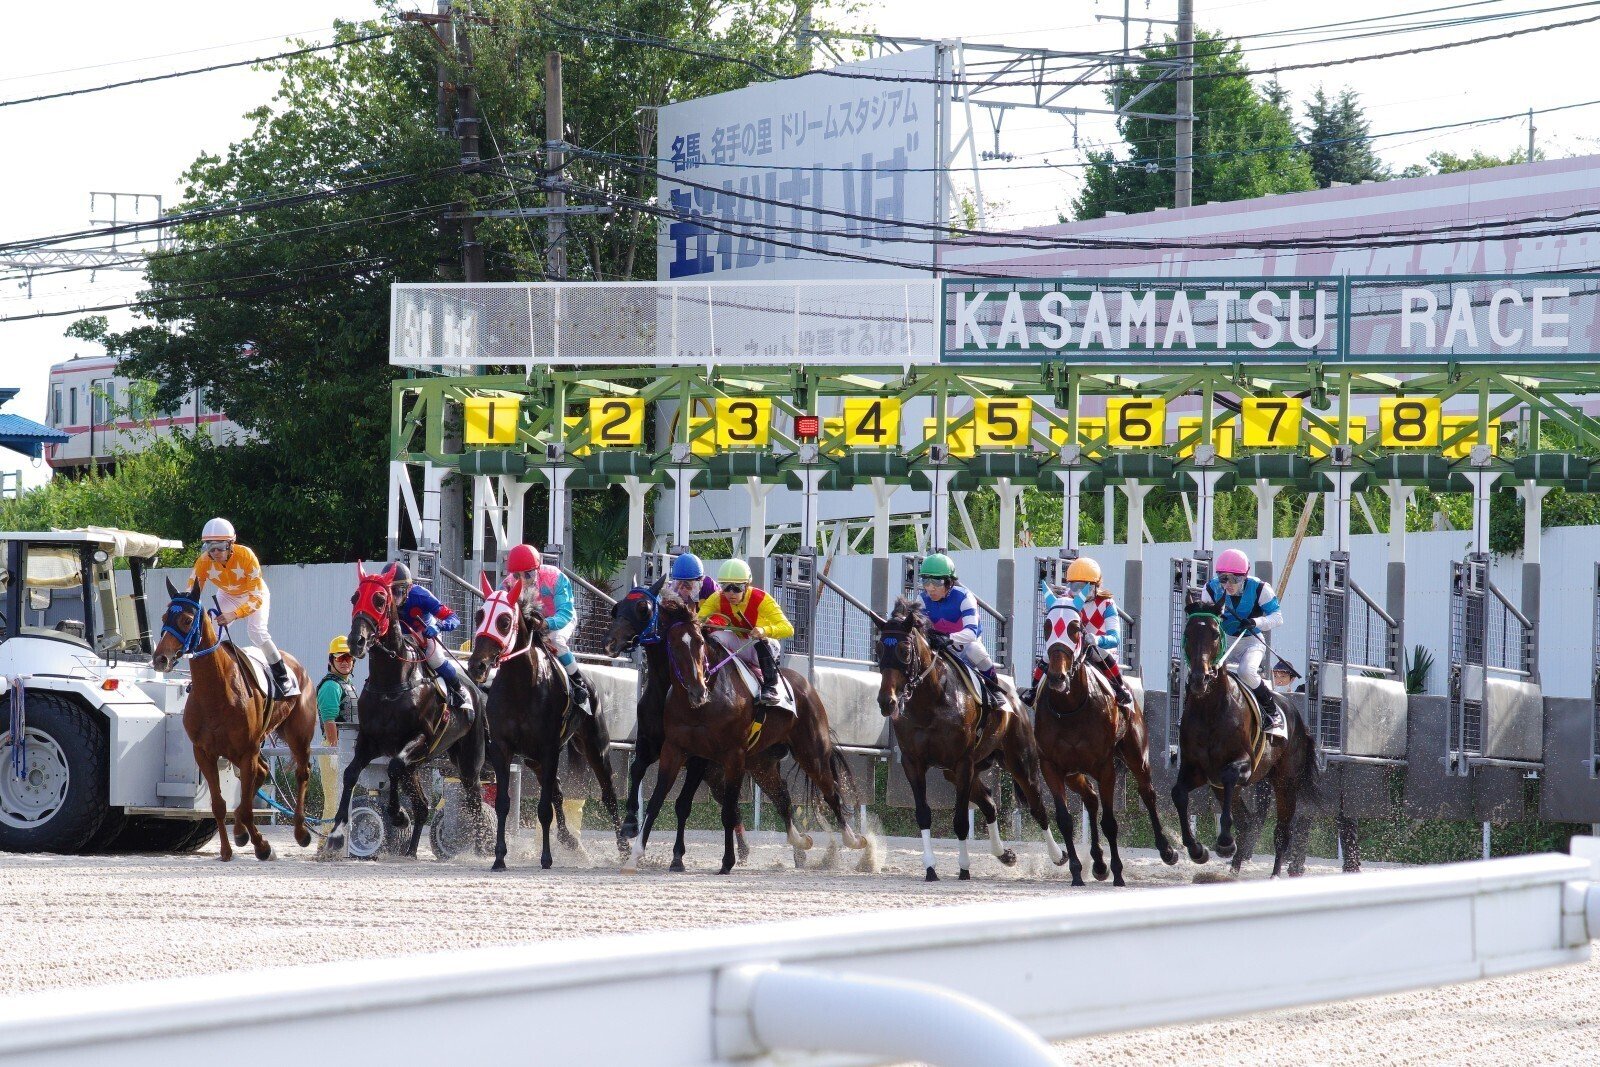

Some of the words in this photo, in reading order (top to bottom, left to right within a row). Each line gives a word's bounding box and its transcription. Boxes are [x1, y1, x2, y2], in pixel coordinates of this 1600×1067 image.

[781, 88, 919, 150] ドリームスタジアム
[955, 290, 1326, 349] KASAMATSU
[1401, 287, 1570, 347] RACE
[488, 402, 495, 440] 1
[601, 401, 631, 441] 2
[728, 401, 758, 441] 3
[855, 402, 887, 443] 4
[987, 402, 1018, 441] 5
[1119, 402, 1153, 442] 6
[1256, 402, 1288, 442] 7
[1392, 402, 1427, 442] 8
